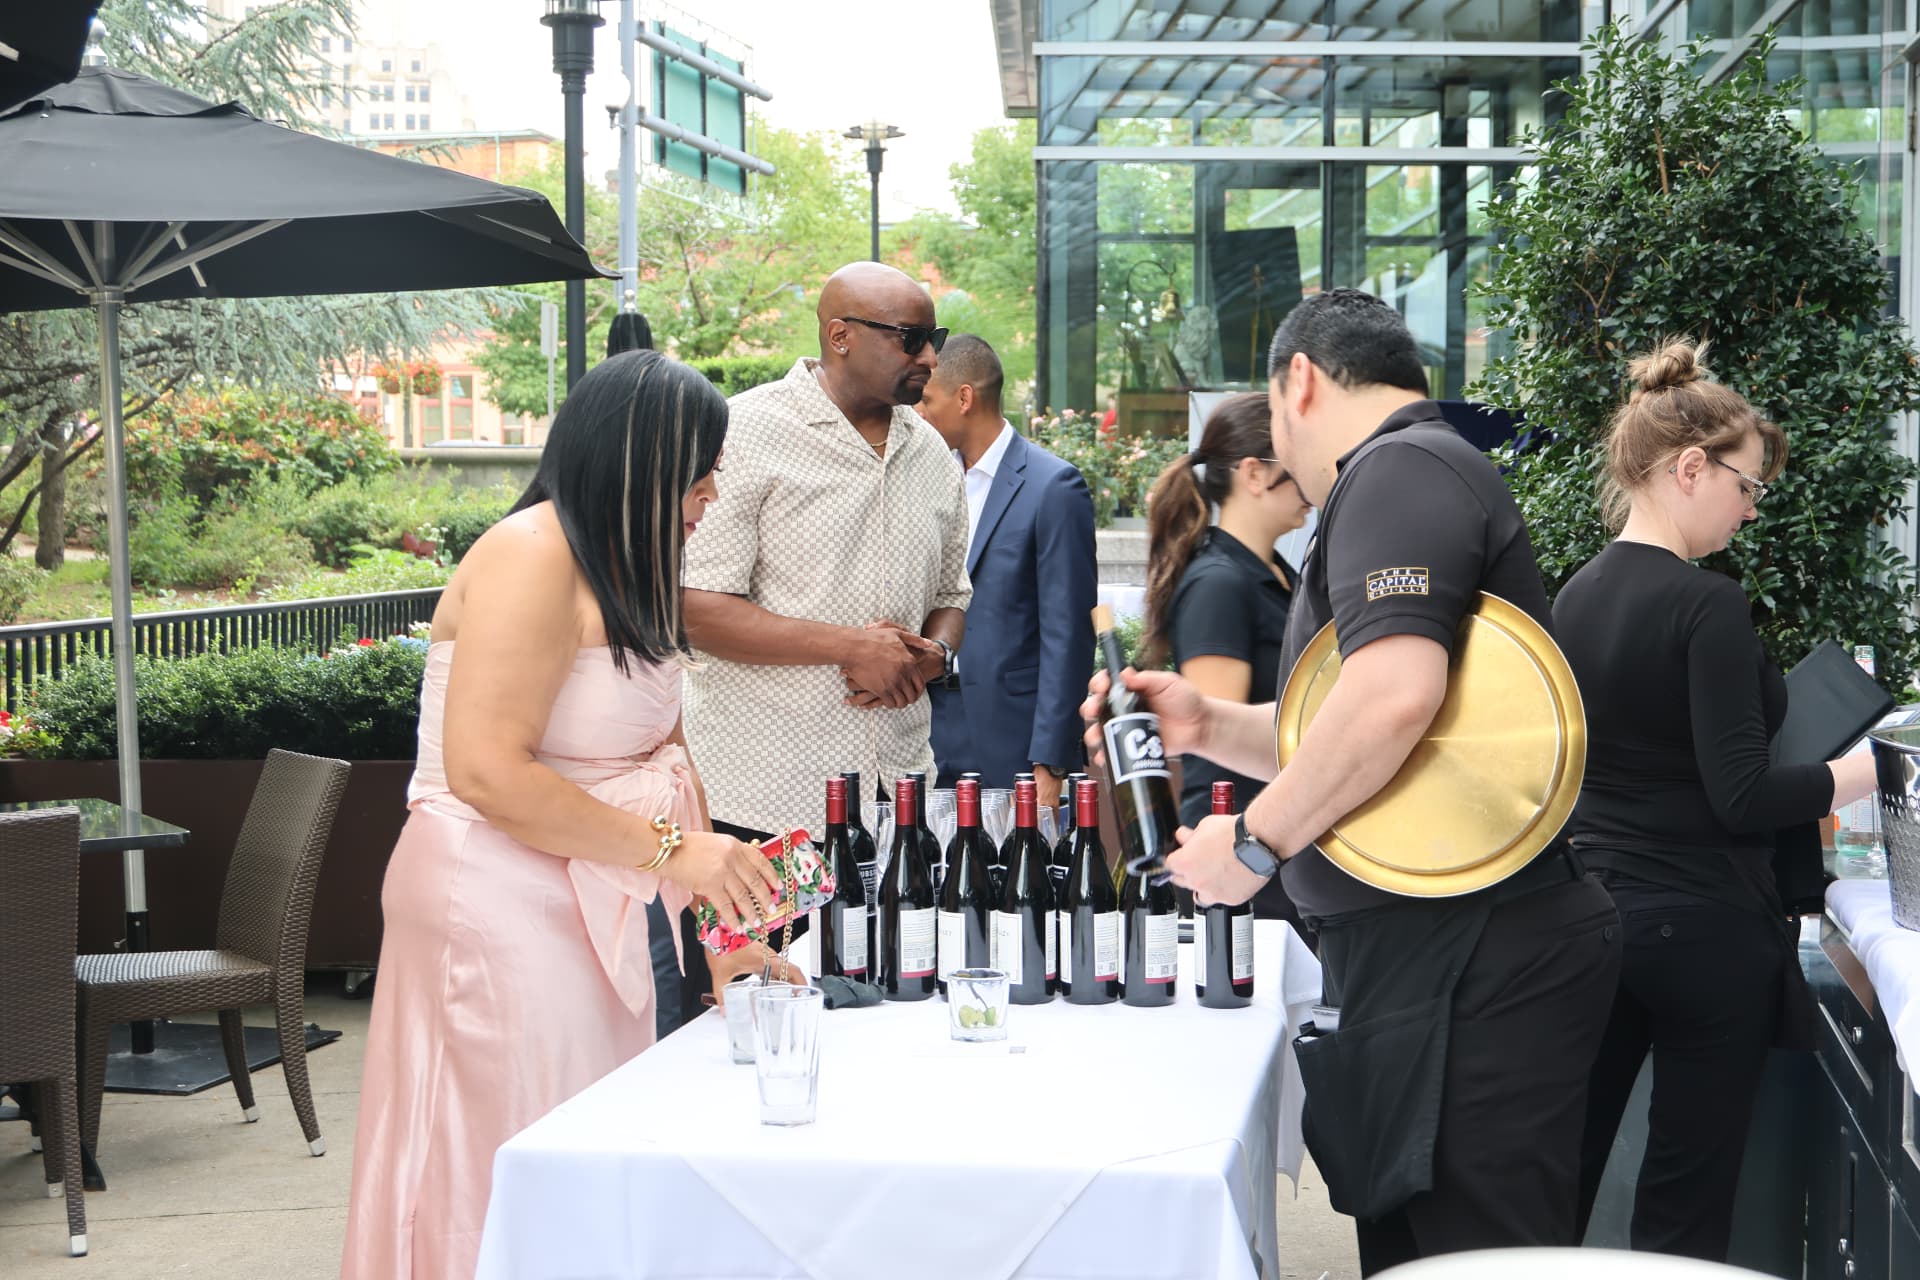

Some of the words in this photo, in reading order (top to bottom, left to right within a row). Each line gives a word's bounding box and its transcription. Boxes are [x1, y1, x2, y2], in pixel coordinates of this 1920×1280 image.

[1382, 569, 1411, 577] THE
[1369, 576, 1426, 591] CAPITAL
[1124, 728, 1164, 759] Cs
